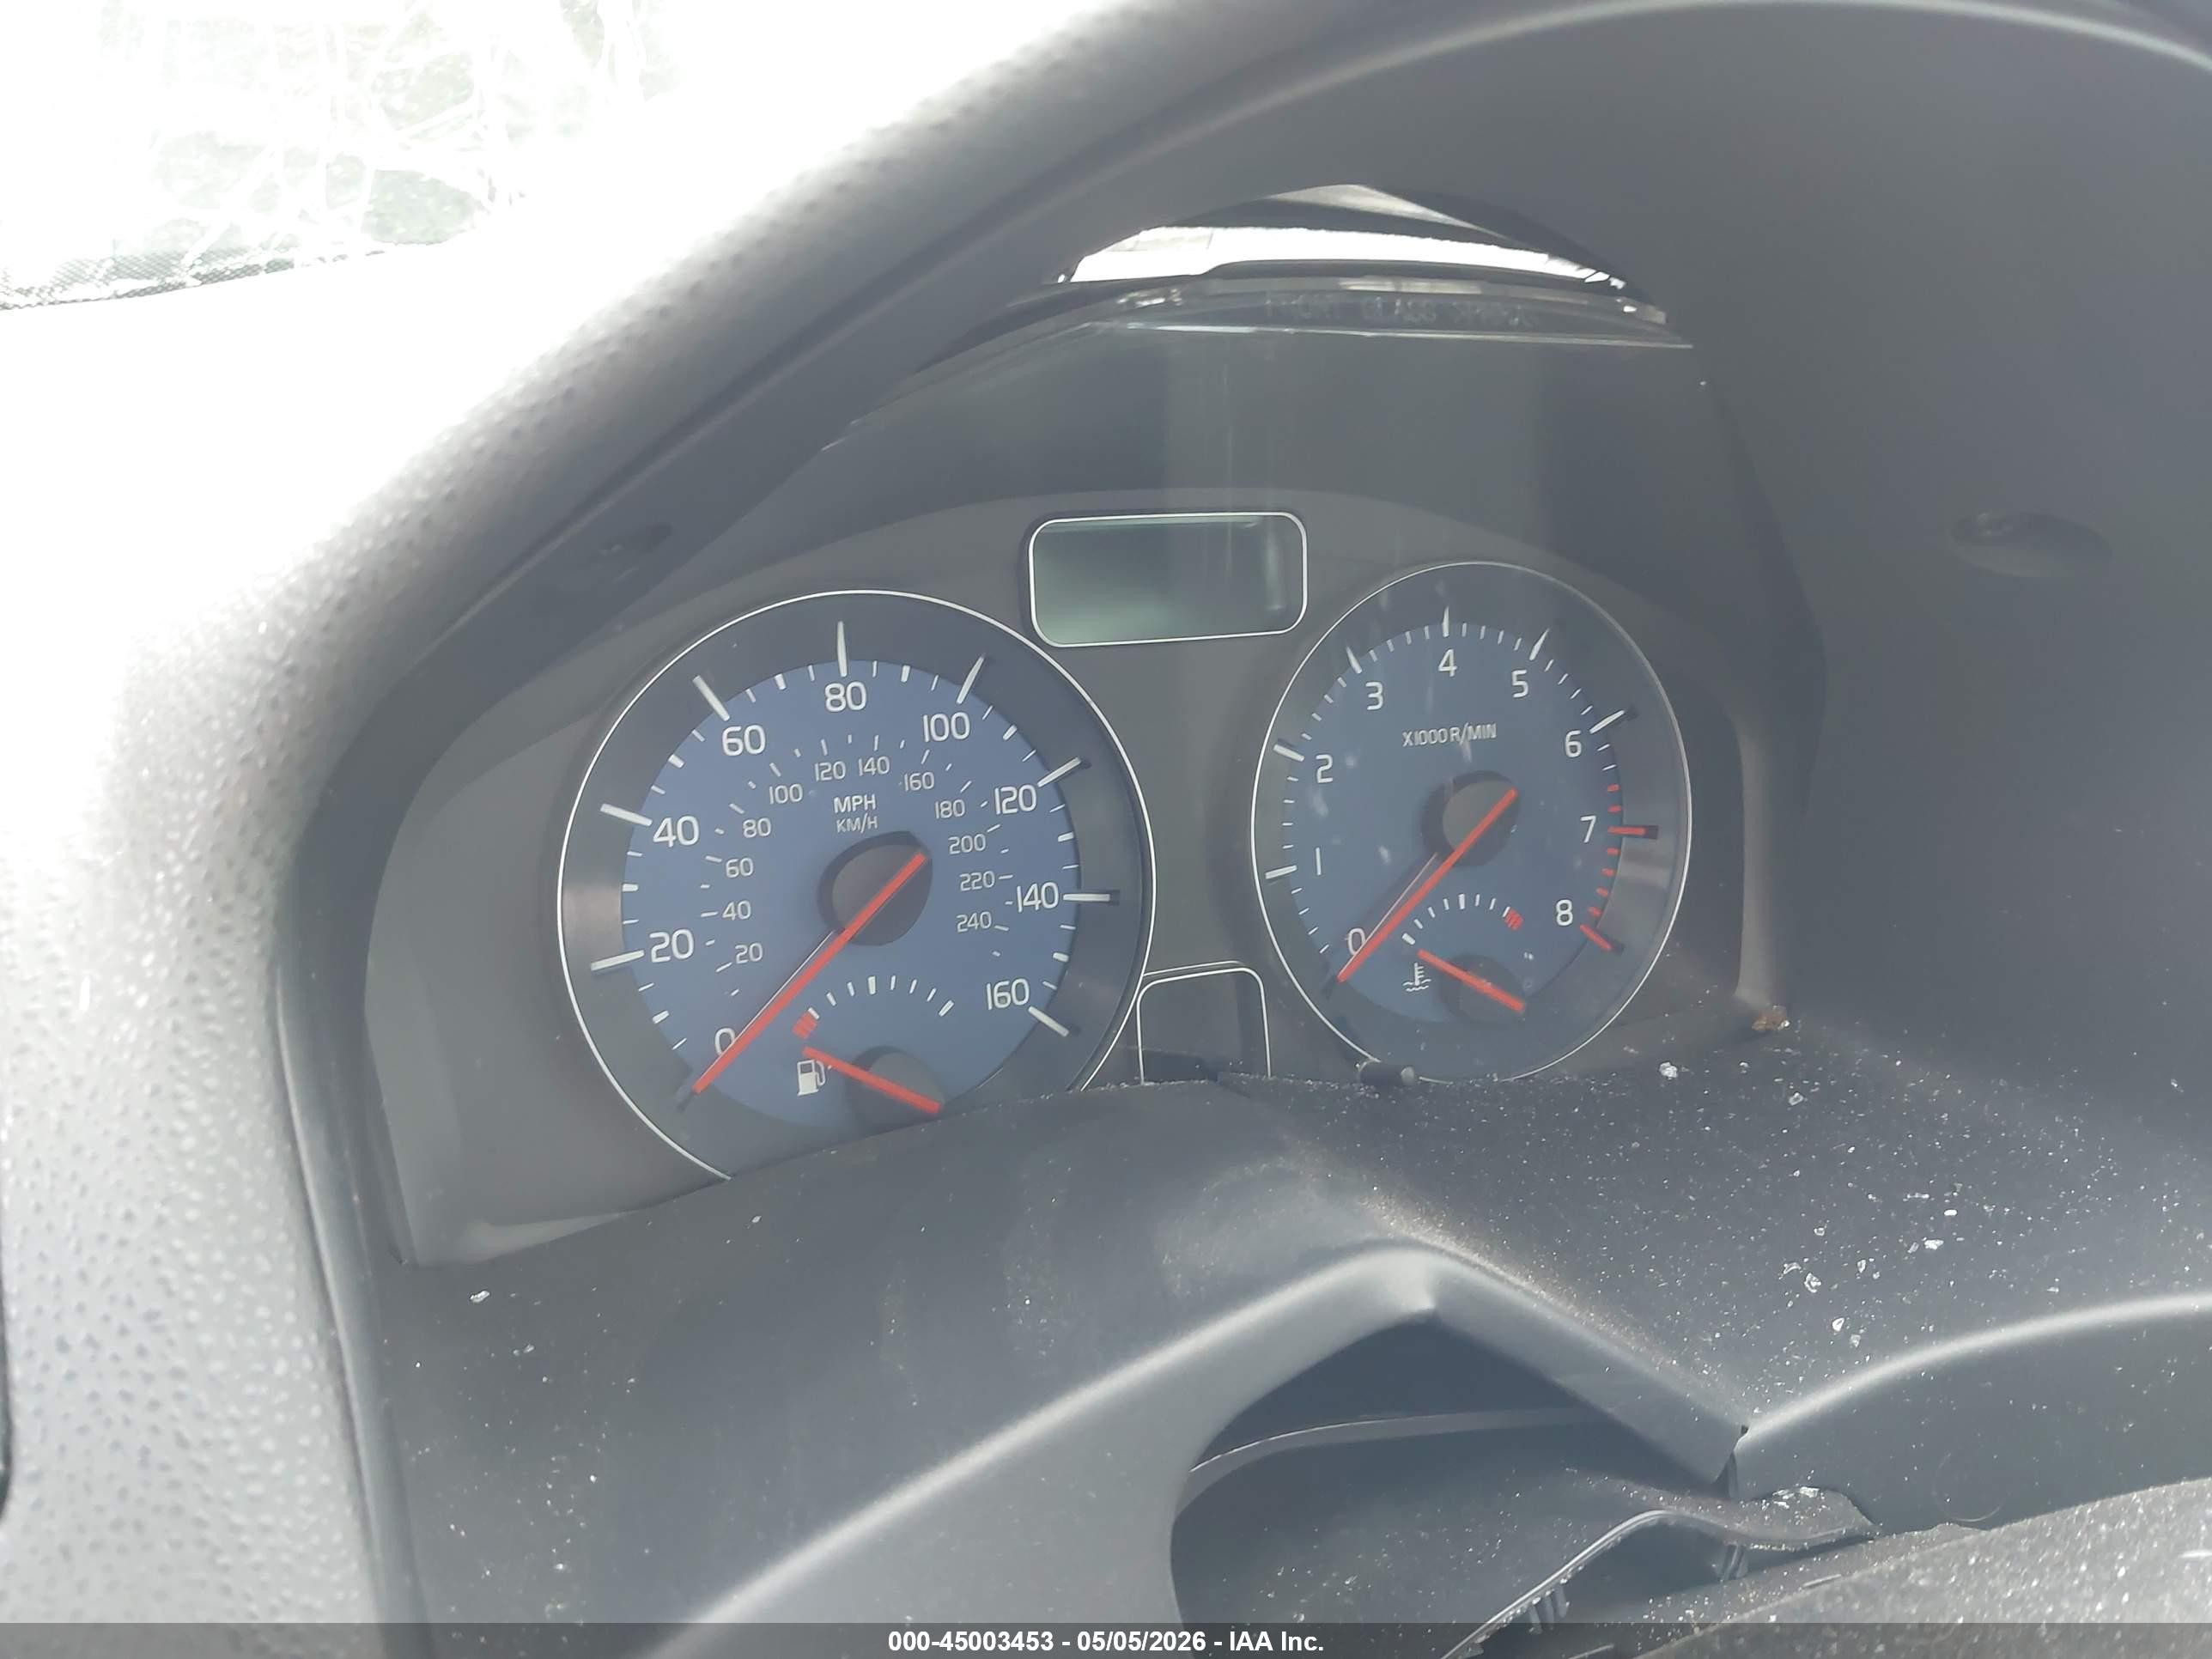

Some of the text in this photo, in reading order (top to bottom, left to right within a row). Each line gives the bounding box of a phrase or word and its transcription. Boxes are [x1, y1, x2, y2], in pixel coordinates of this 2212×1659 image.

[1439, 649, 1456, 676] 4
[825, 682, 866, 711] 80
[1366, 682, 1382, 709] 3
[1512, 670, 1528, 697] 5
[923, 713, 969, 742] 100
[722, 726, 765, 756] 60
[1565, 731, 1581, 757] 6
[815, 762, 845, 781] 120
[859, 757, 890, 775] 140
[1316, 755, 1333, 782] 2
[769, 784, 802, 804] 100
[903, 772, 935, 792] 160
[833, 794, 877, 813] MPH
[935, 799, 964, 818] 180
[994, 785, 1037, 815] 120
[653, 816, 699, 847] 40
[744, 818, 770, 837] 80
[835, 814, 878, 833] KM/H
[1581, 816, 1595, 842] 7
[948, 833, 987, 854] 200
[726, 858, 753, 878] 60
[960, 872, 994, 890] 220
[1018, 883, 1058, 912] 140
[723, 901, 750, 921] 40
[957, 912, 992, 933] 240
[1557, 900, 1572, 926] 8
[650, 929, 693, 962] 20
[735, 943, 763, 963] 20
[1347, 927, 1367, 956] 0
[987, 979, 1029, 1010] 160
[714, 1028, 737, 1057] 0
